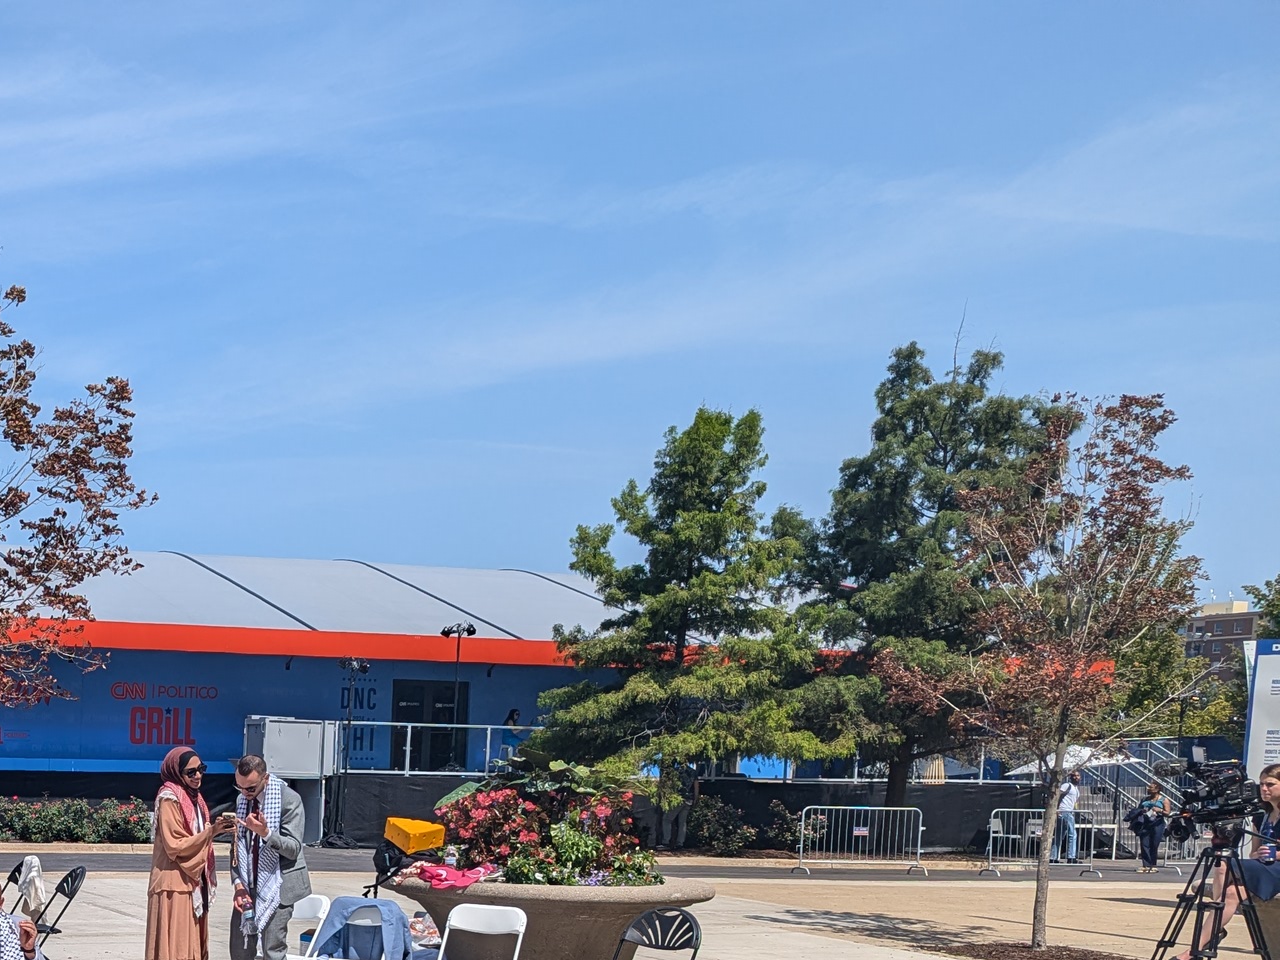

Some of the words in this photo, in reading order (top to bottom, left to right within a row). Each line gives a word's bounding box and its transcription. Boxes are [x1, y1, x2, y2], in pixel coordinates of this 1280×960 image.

[110, 681, 147, 700] CNN
[157, 685, 219, 700] POLITICO
[340, 686, 377, 711] DNC
